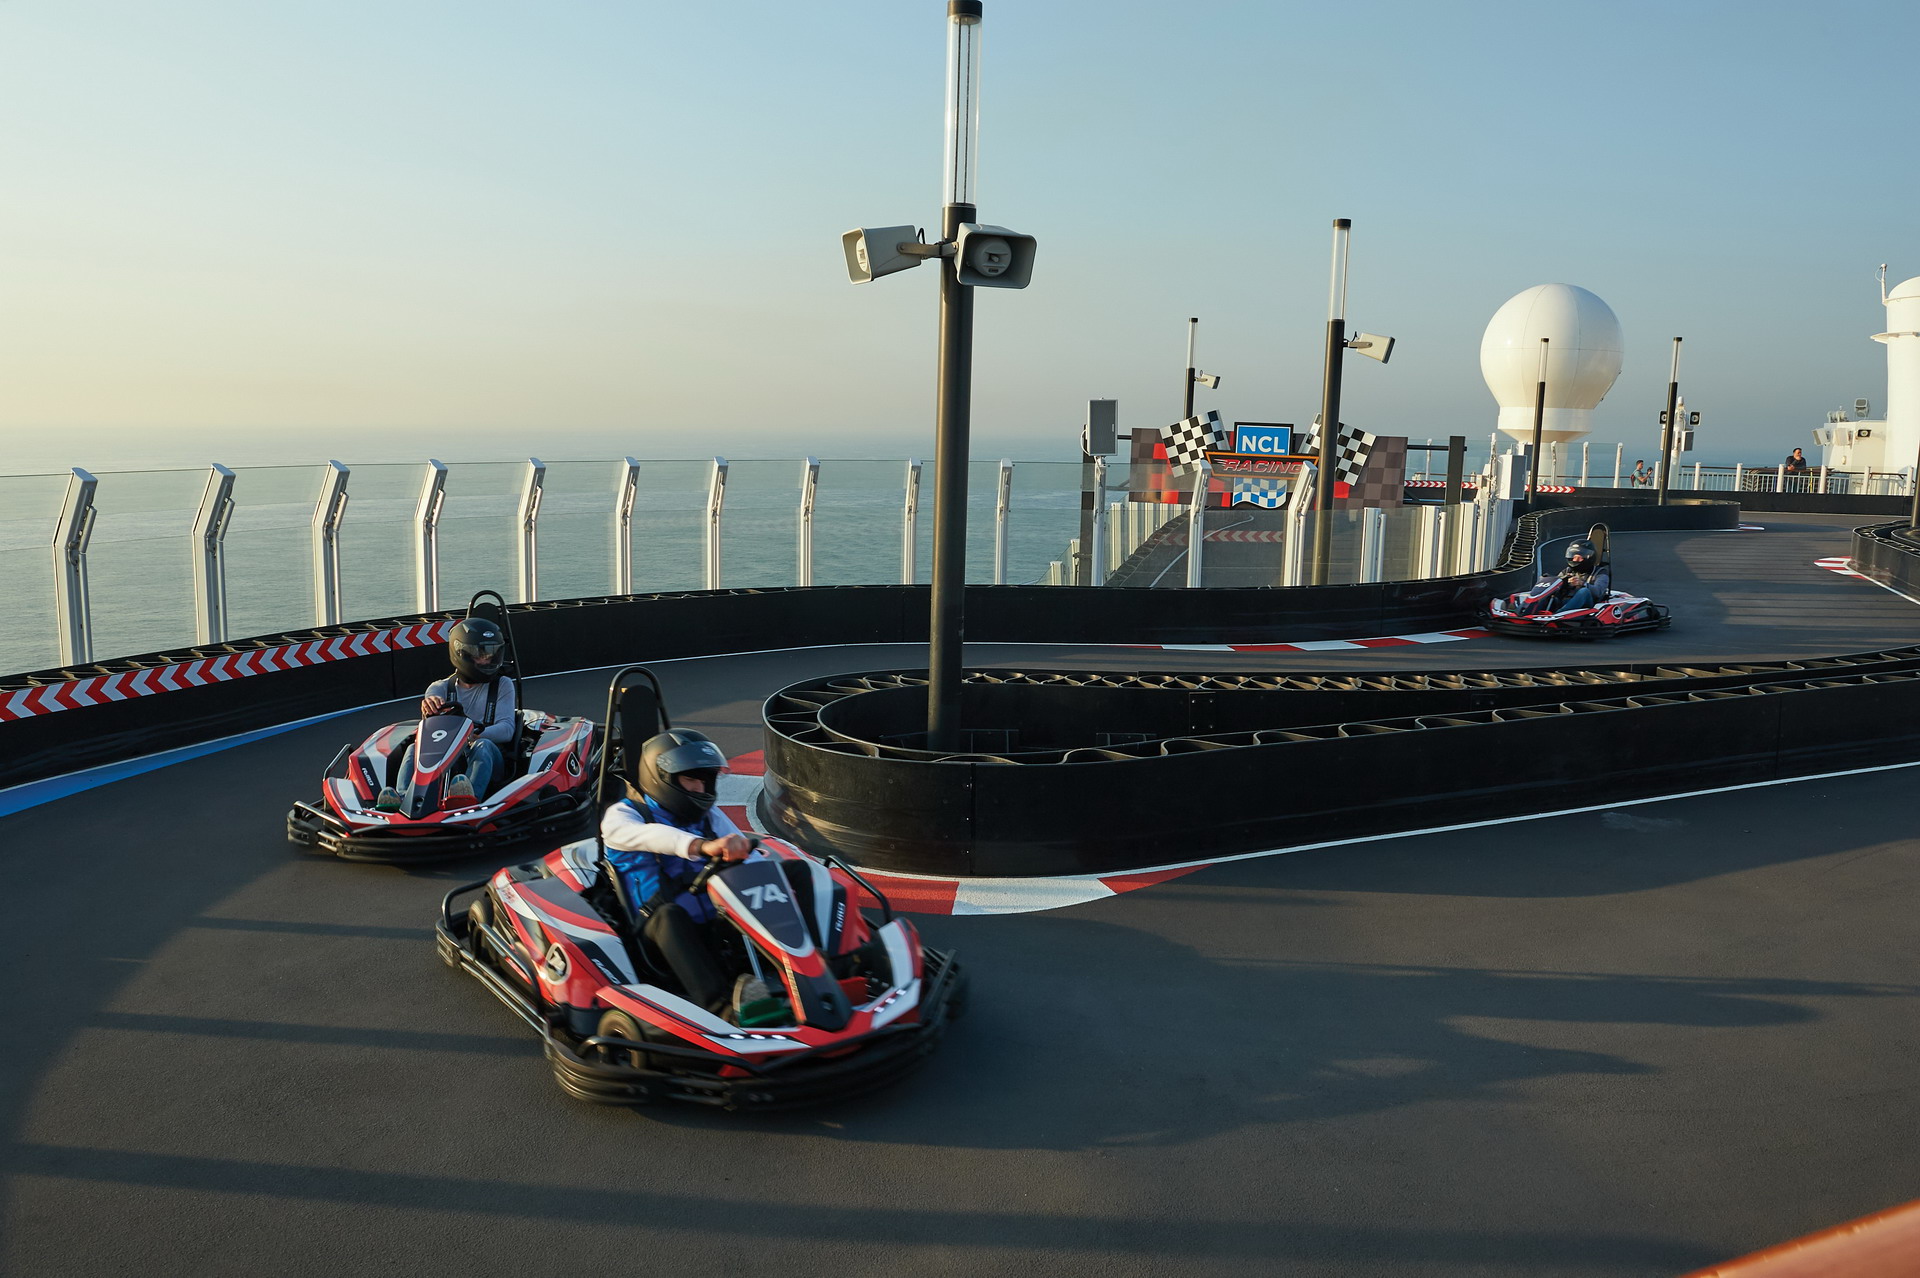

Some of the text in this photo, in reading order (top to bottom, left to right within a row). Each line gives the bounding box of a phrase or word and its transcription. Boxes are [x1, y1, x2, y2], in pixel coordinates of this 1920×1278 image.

[1241, 435, 1286, 453] NCL
[1218, 458, 1304, 475] RACING
[431, 729, 448, 742] 9
[570, 759, 576, 770] 9
[741, 883, 789, 910] 74
